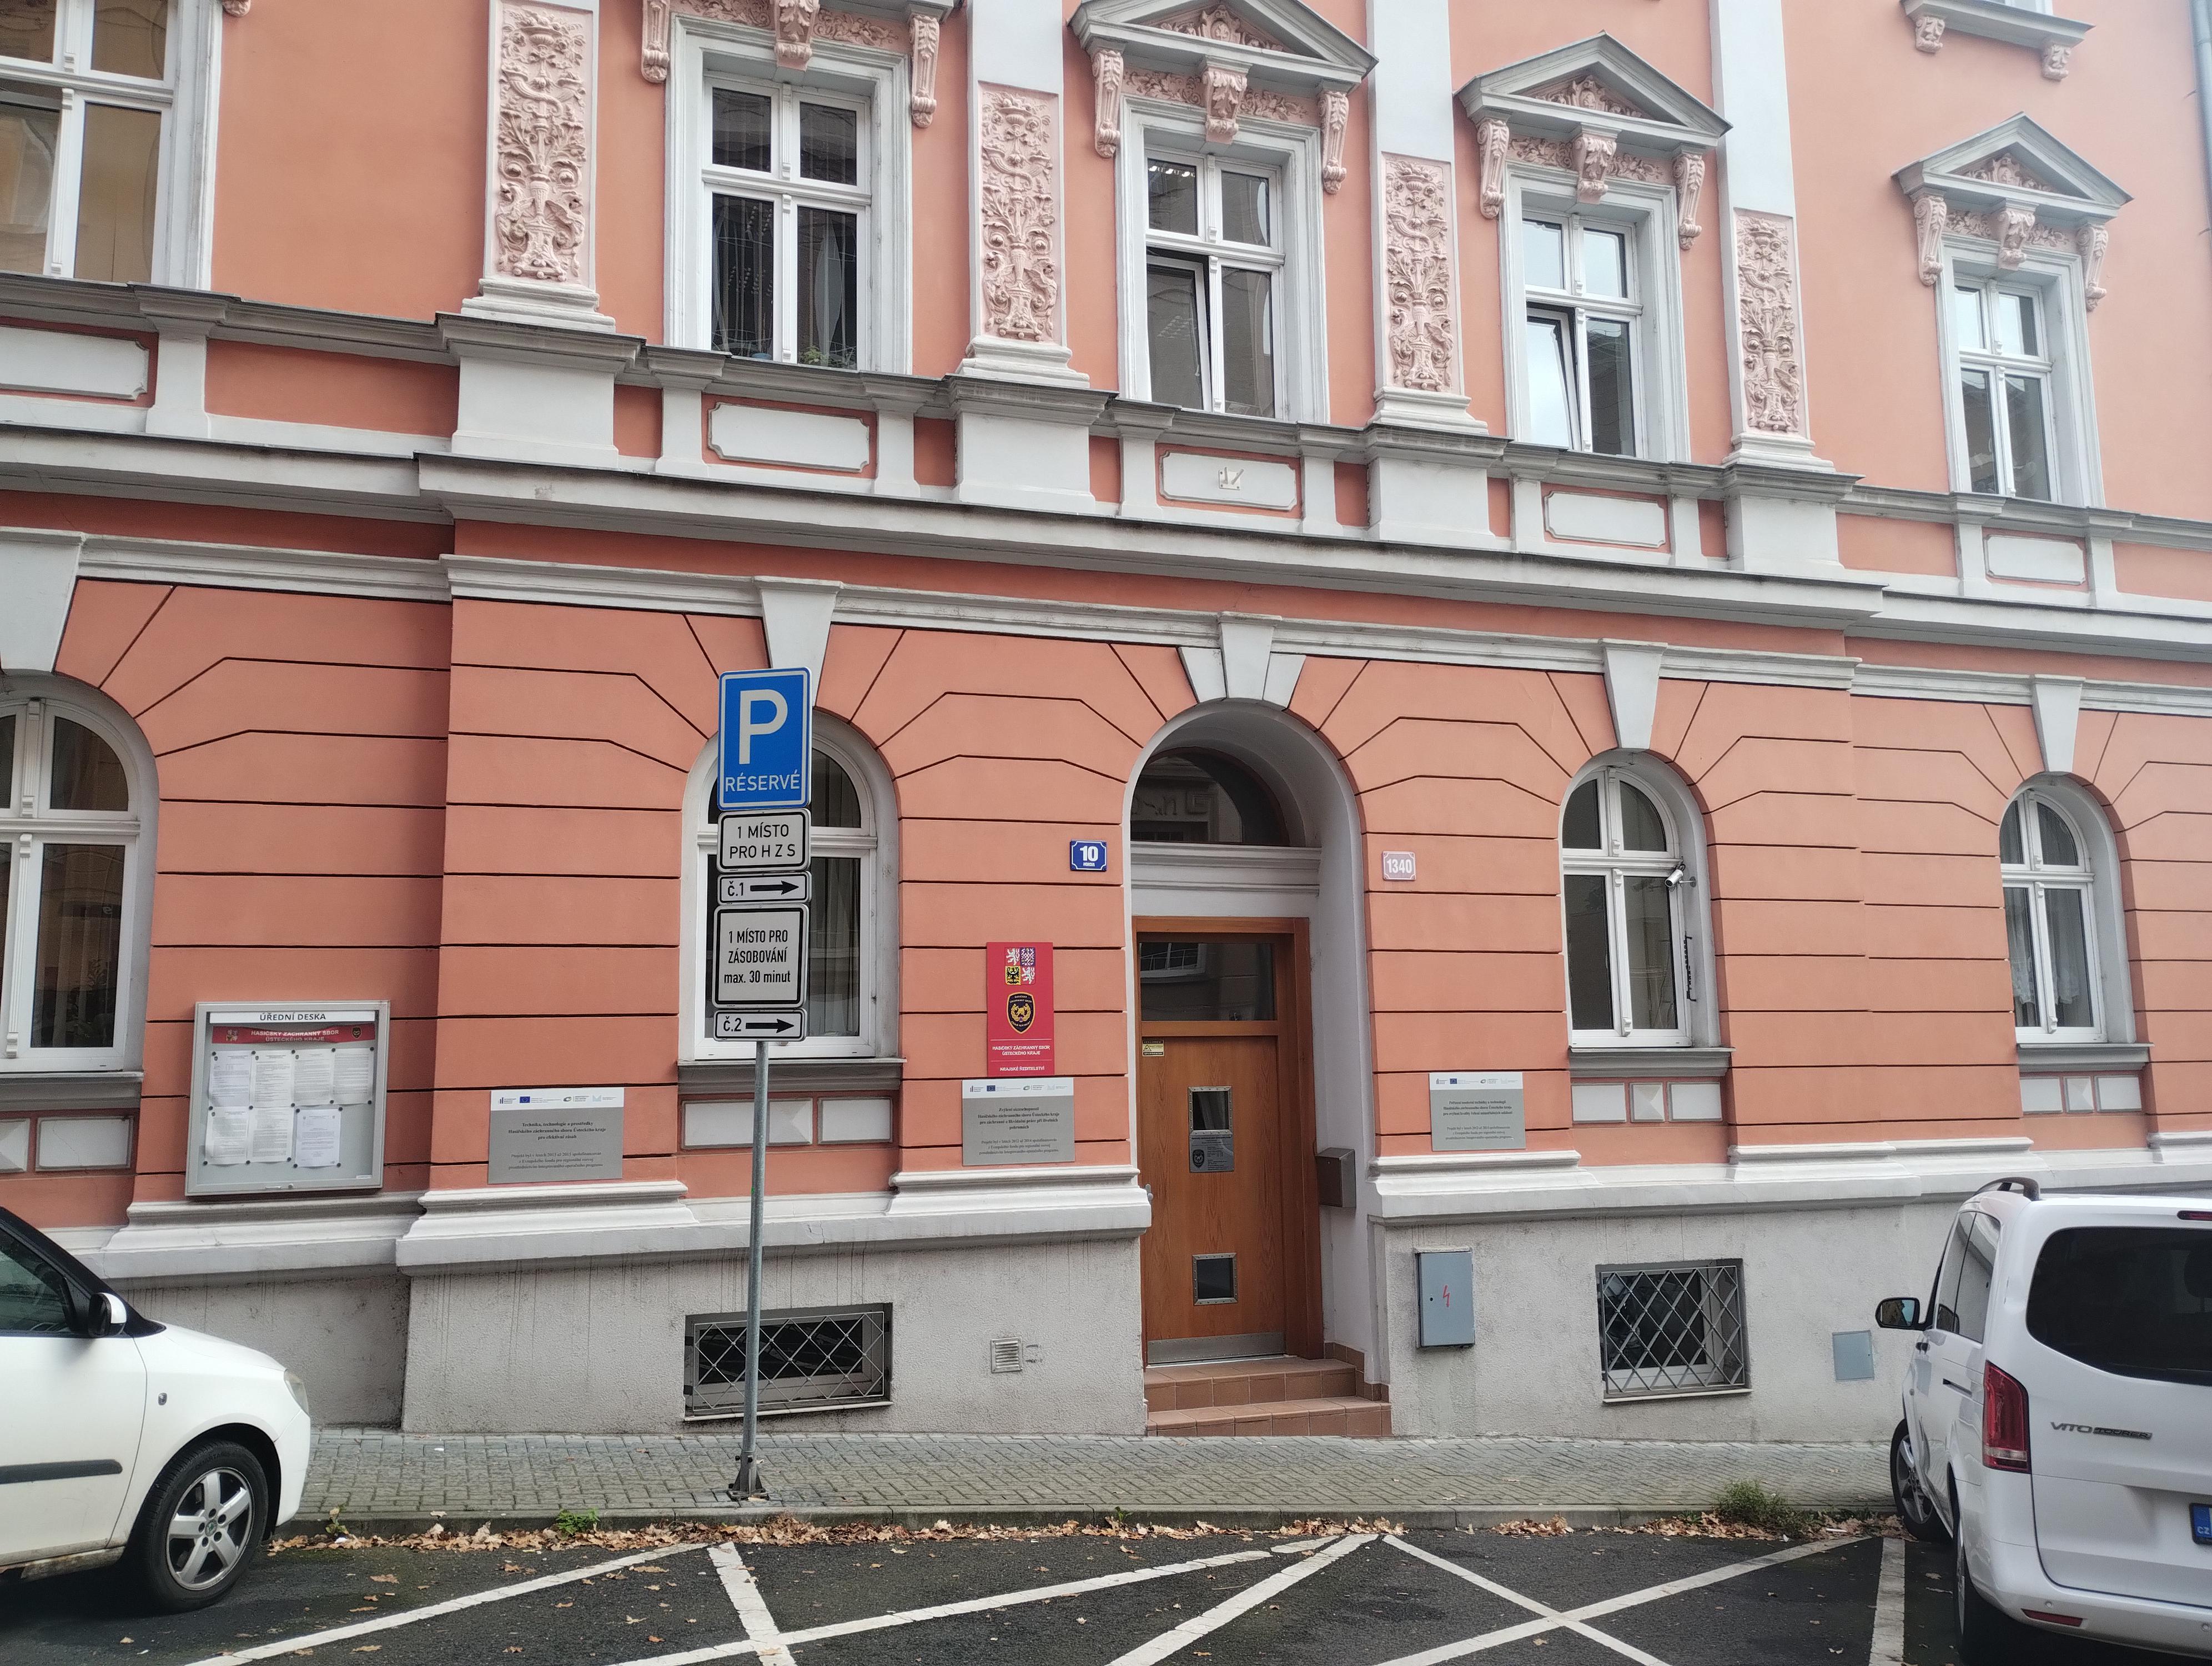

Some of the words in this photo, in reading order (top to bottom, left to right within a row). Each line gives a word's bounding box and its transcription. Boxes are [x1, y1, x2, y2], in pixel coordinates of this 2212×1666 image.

[739, 689, 788, 765] P
[726, 769, 800, 792] RÉSERVÉ
[737, 826, 742, 839] 1
[748, 822, 789, 839] MÍSTO
[730, 845, 757, 859] PRO
[1079, 846, 1098, 861] 10
[1386, 859, 1412, 874] 1340
[728, 931, 733, 943] 1
[737, 927, 765, 943] MÍSTO
[769, 930, 788, 942] PRO
[728, 947, 788, 964] ZÁSOBOVÁNÍ
[723, 974, 746, 983] max.
[749, 970, 761, 983] 30
[763, 970, 791, 983] minut
[260, 1012, 295, 1021] ÚŘEDNÍ
[2050, 1422, 2093, 1434] VITO
[2095, 1428, 2151, 1440] TOURER
[2197, 1526, 2210, 1535] CZ
